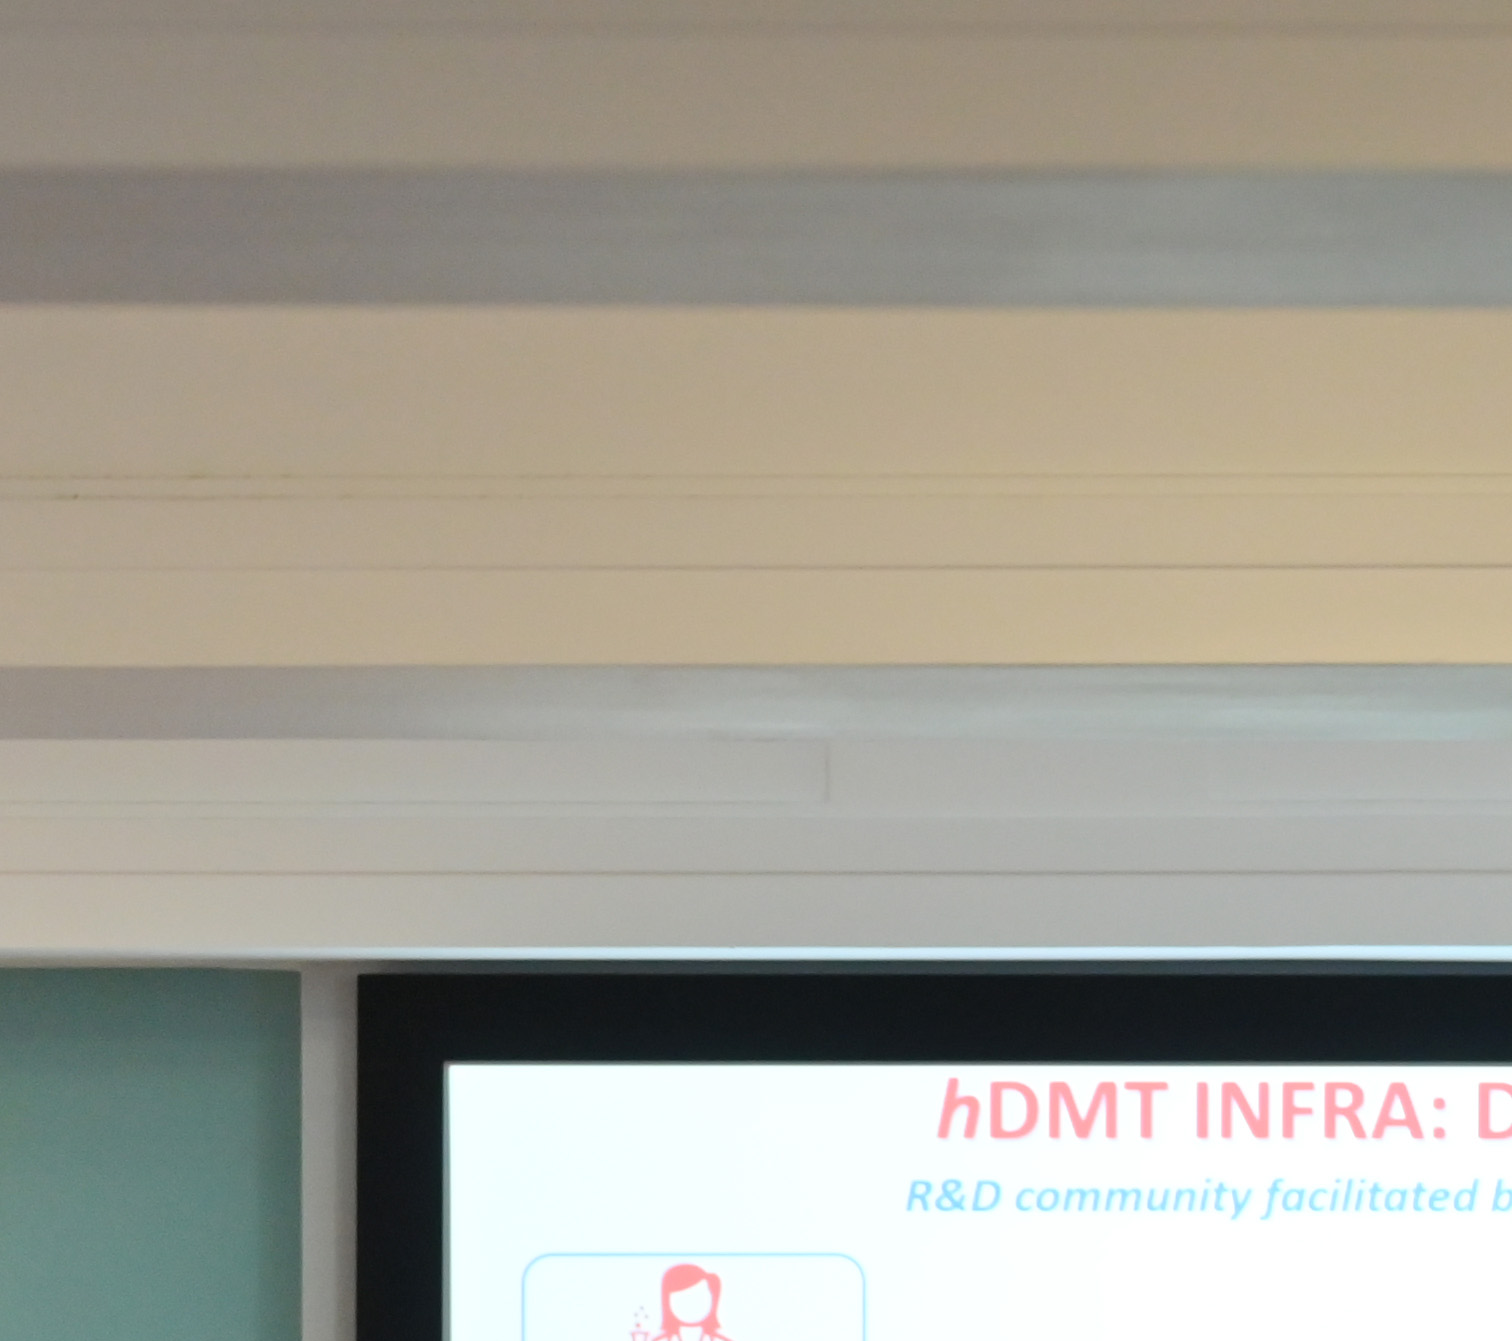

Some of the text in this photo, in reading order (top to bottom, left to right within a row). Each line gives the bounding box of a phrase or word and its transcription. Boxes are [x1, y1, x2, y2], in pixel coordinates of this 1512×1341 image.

[937, 1077, 1168, 1141] hDMT
[1195, 1080, 1446, 1141] INFRA:
[906, 1179, 1003, 1213] R&D
[1015, 1179, 1252, 1220] community
[1260, 1178, 1476, 1220] facilitated
